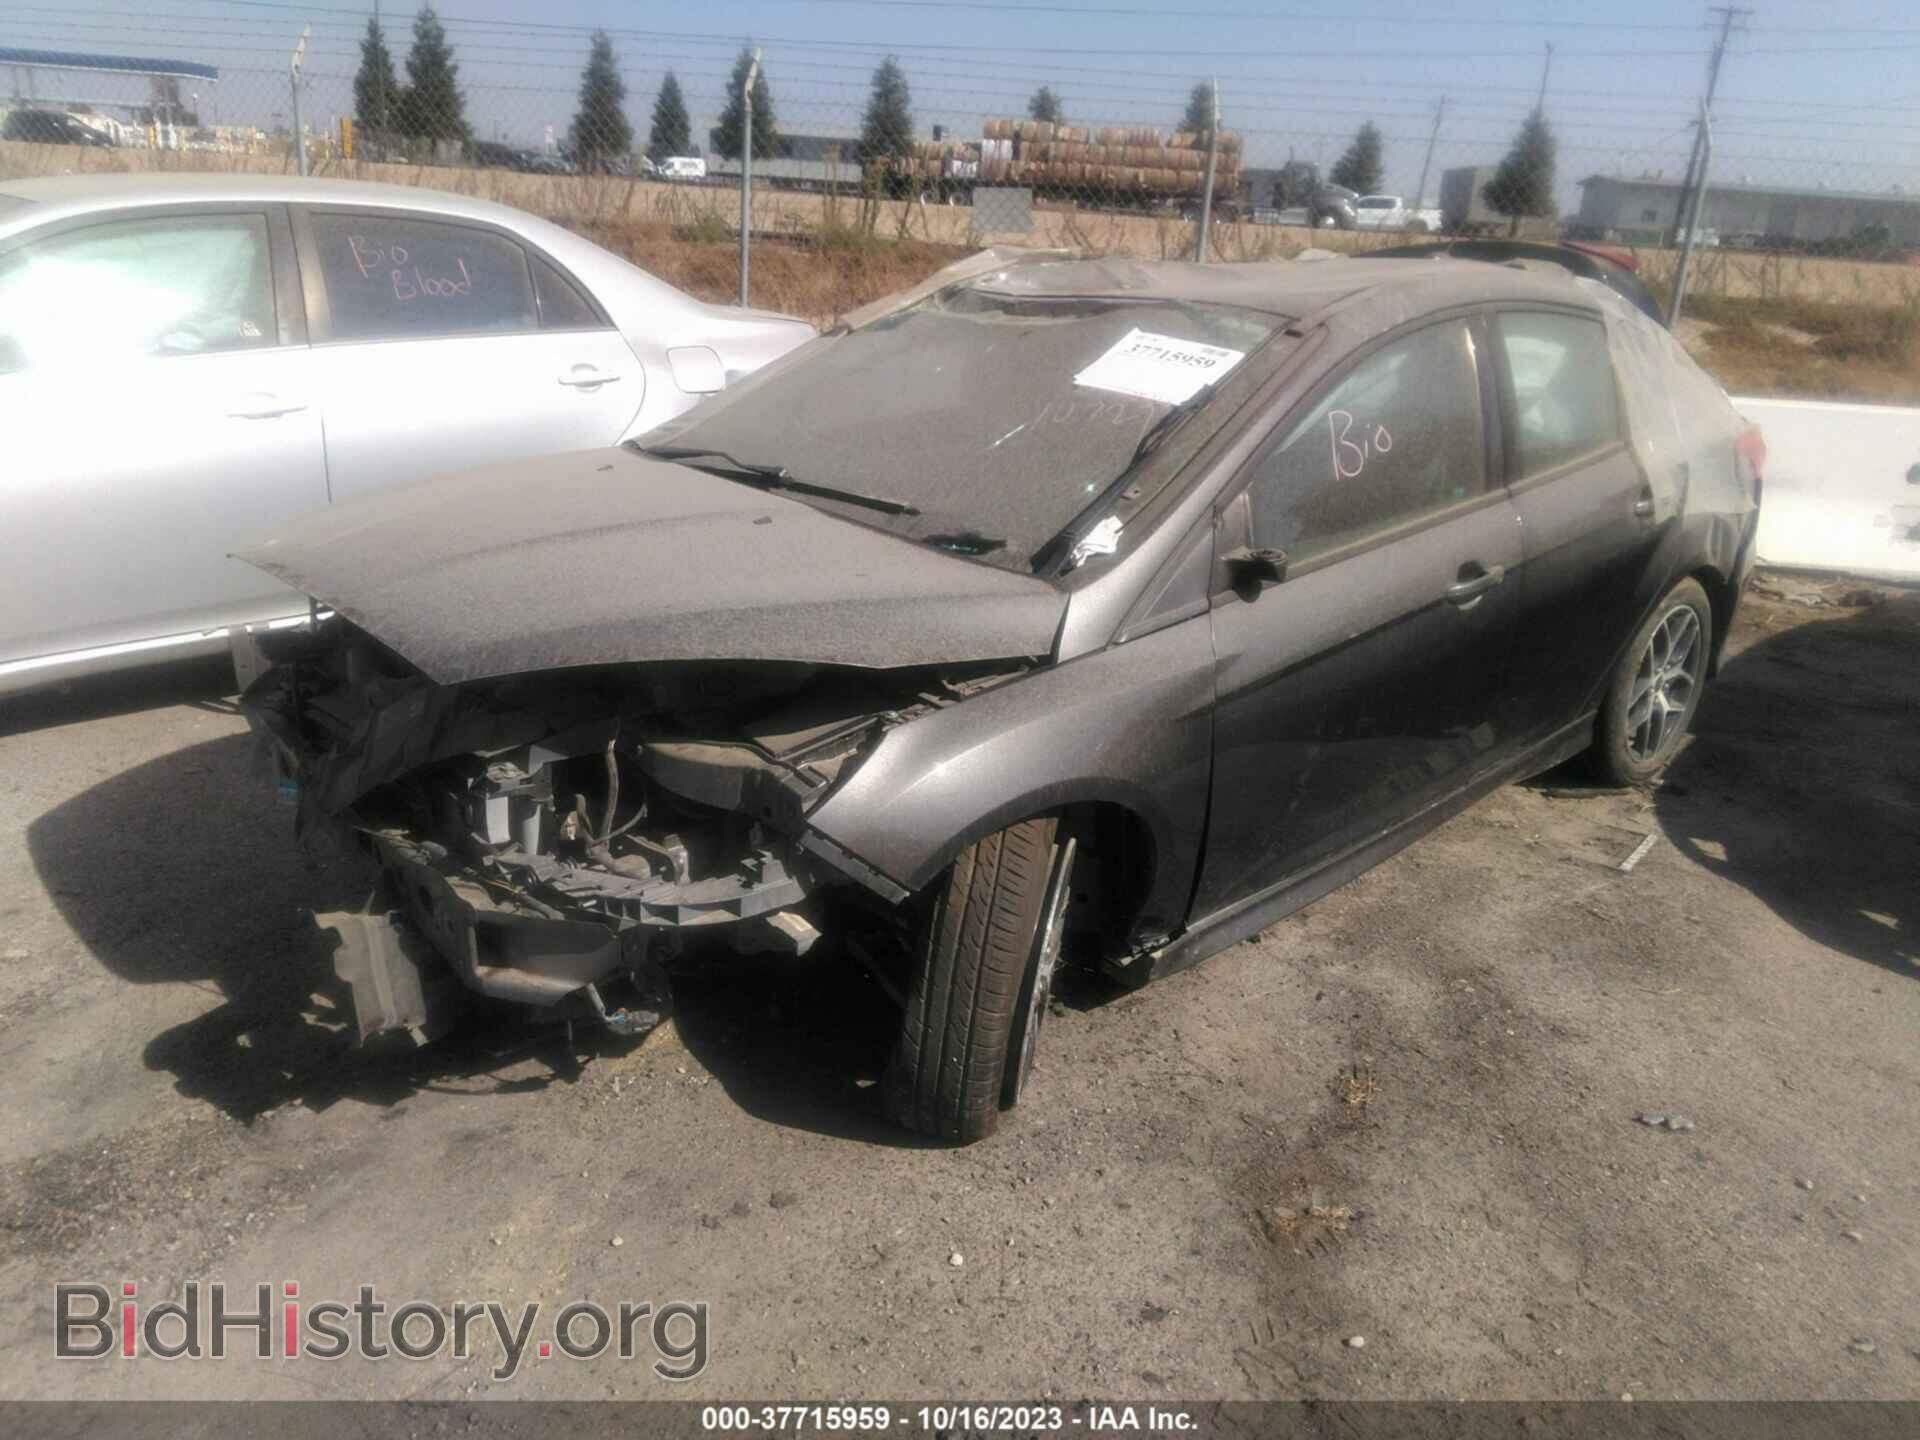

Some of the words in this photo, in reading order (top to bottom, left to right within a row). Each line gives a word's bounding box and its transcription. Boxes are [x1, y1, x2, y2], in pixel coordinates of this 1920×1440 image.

[347, 235, 408, 278] Bio
[391, 257, 471, 299] Blood
[1123, 343, 1217, 369] 37715959
[1328, 409, 1393, 481] Bio
